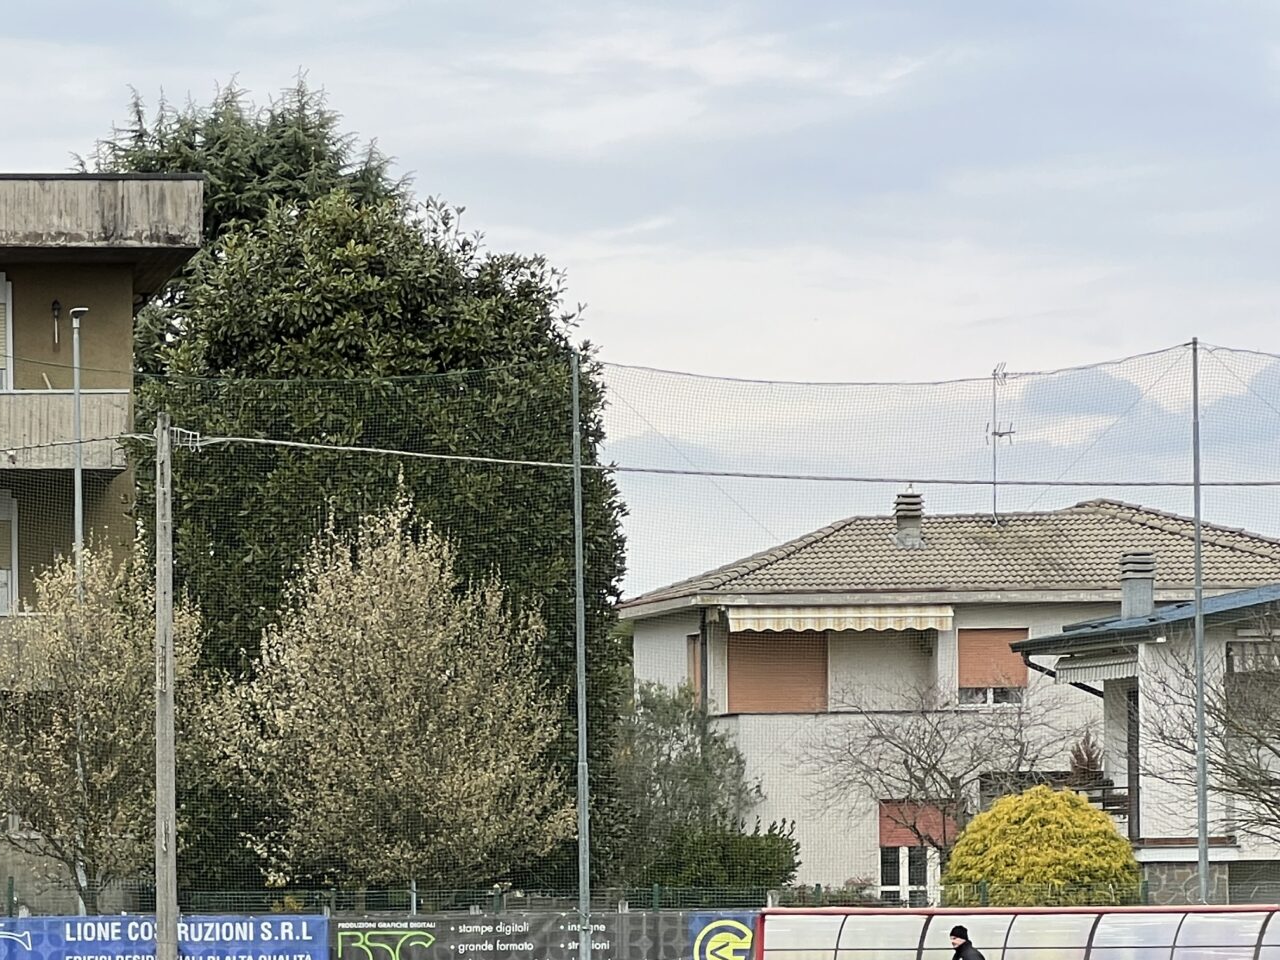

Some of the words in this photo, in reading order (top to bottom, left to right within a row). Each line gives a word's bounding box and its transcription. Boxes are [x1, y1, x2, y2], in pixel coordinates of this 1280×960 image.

[66, 922, 121, 942] LIONE
[128, 922, 254, 942] CORUZIONI
[260, 921, 312, 940] S.R.L
[458, 923, 493, 935] stampe
[496, 922, 529, 934] digitali
[458, 941, 493, 953] grande
[496, 940, 534, 951] formato
